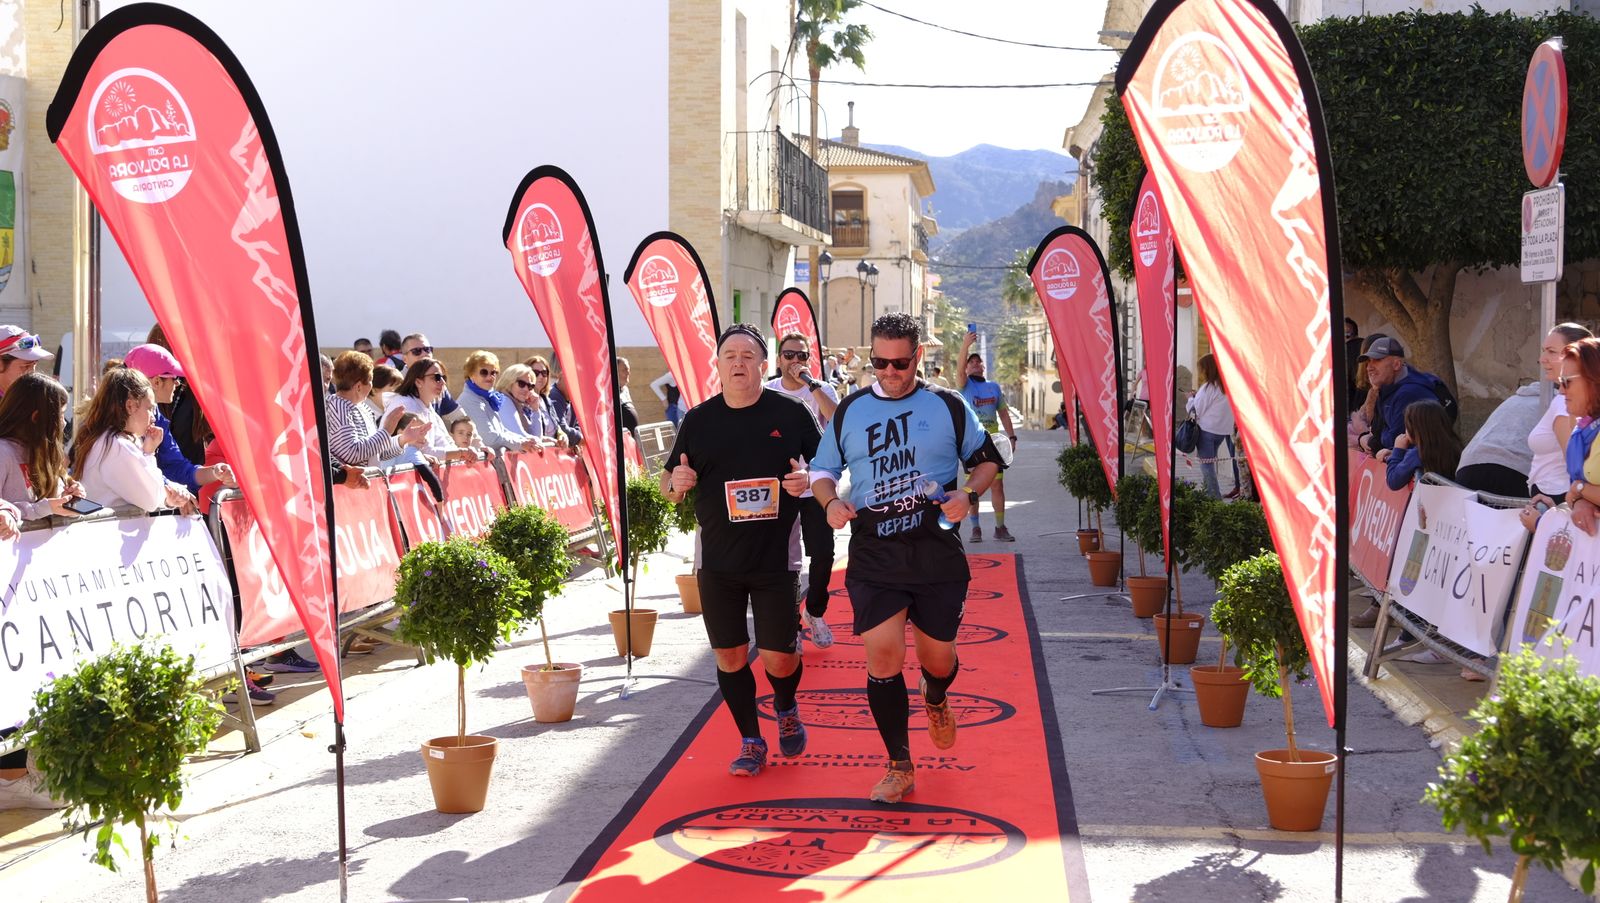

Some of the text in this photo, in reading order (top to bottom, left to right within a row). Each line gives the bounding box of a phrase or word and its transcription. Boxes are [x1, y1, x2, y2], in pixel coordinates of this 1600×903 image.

[1533, 191, 1558, 207] PROHIBIDO
[865, 410, 913, 457] EAT
[869, 446, 916, 480] TRAIN
[535, 473, 583, 513] VEOLIA
[736, 488, 770, 503] 387
[873, 470, 921, 502] SLEEP
[876, 510, 925, 537] REPEAT
[1364, 501, 1398, 557] VEOLIA
[177, 553, 206, 576] DE
[335, 519, 391, 578] OLIA
[0, 583, 220, 672] CANTORIA
[714, 813, 978, 826] LA POLVORA
